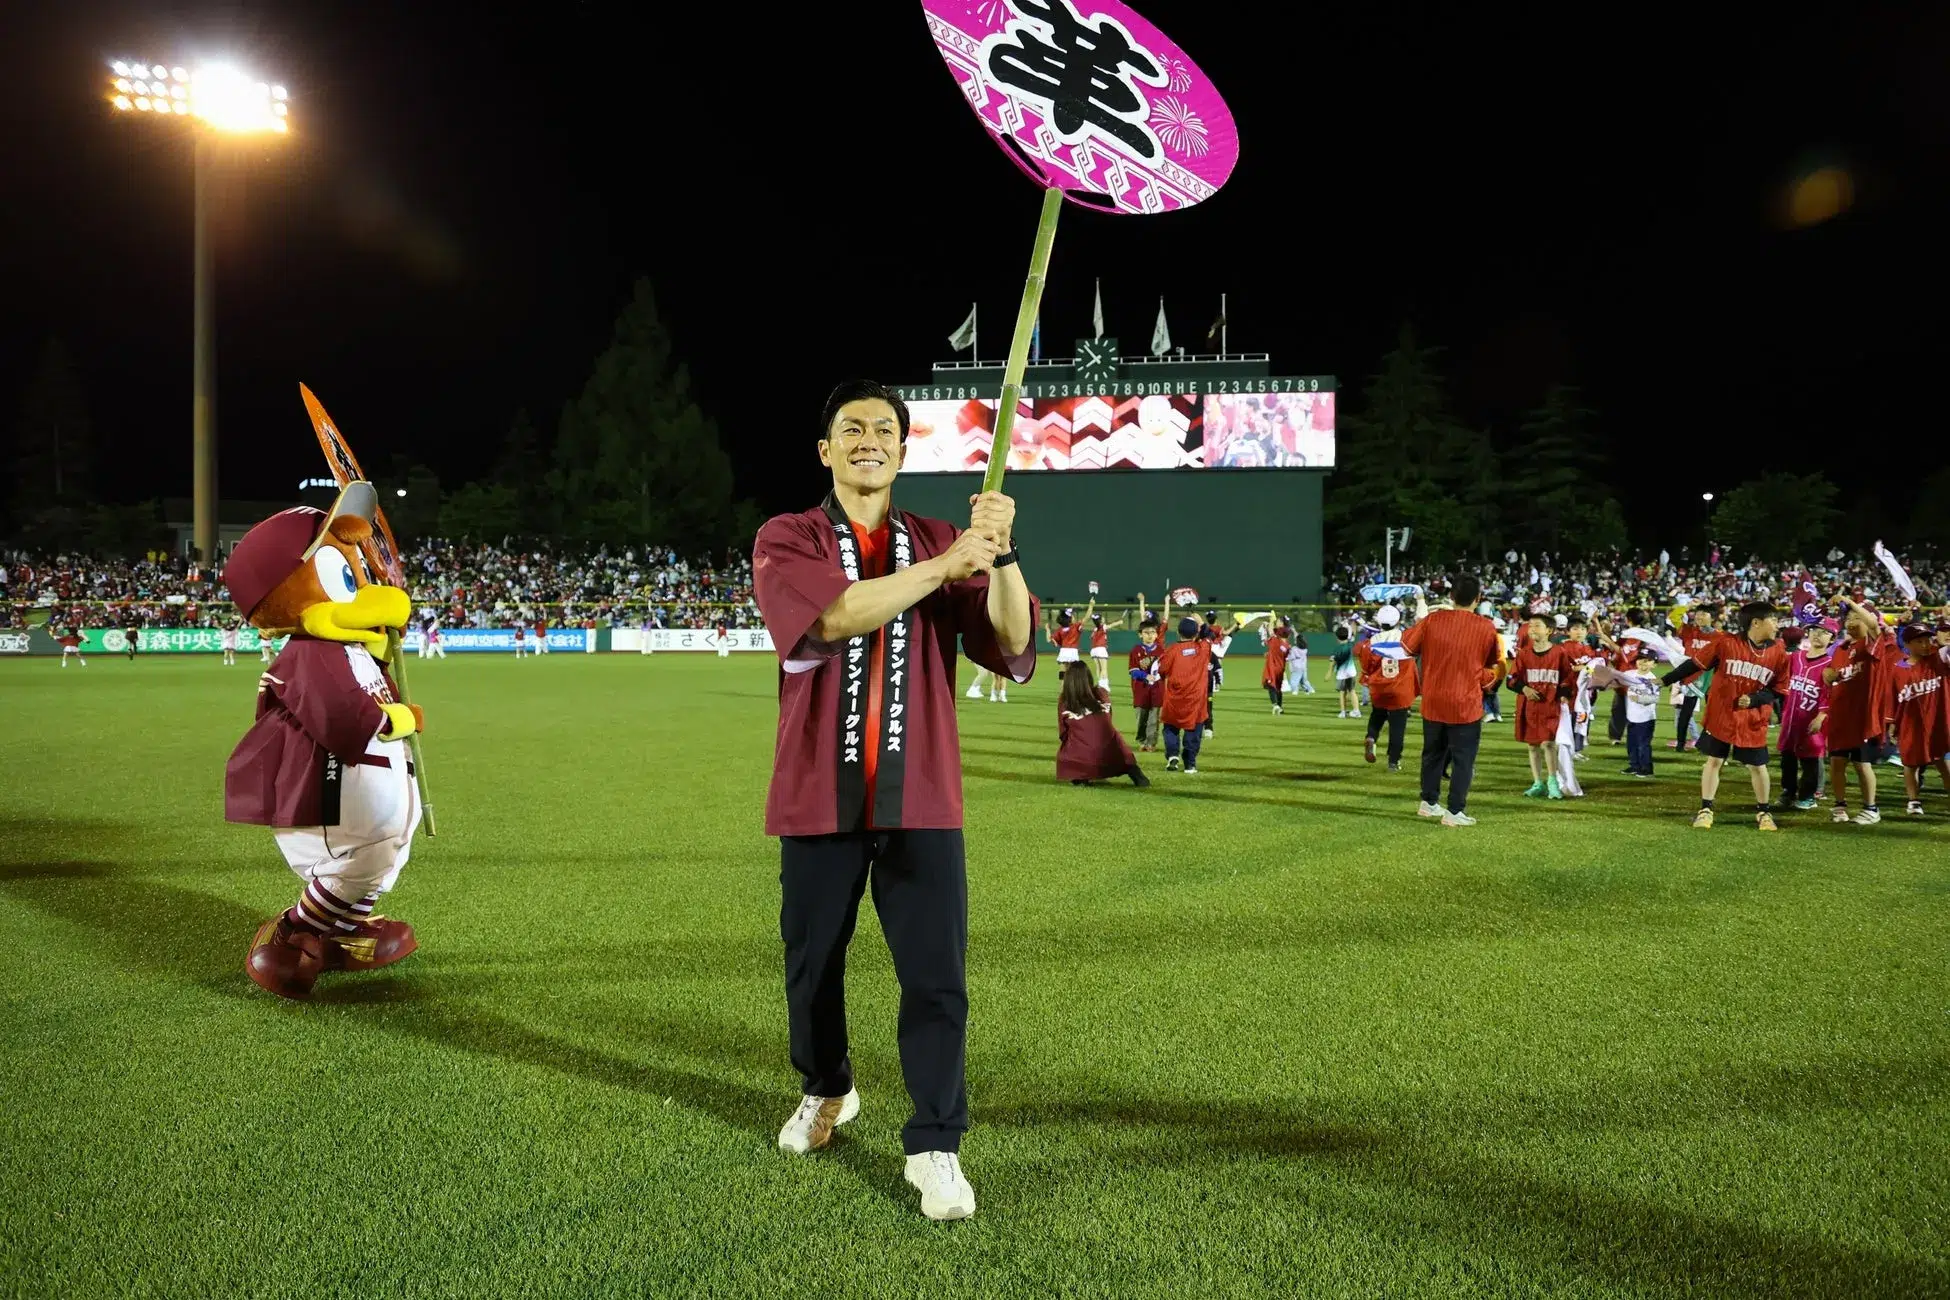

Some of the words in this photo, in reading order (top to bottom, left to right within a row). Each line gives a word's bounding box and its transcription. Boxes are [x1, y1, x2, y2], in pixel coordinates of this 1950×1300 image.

[1038, 385, 1042, 397] 1
[1049, 384, 1056, 397] 2
[1062, 384, 1068, 396] 3
[1074, 384, 1081, 396] 4
[1086, 384, 1094, 396] 5
[1100, 384, 1106, 396] 6
[1112, 384, 1118, 396] 7
[1124, 384, 1132, 395] 8
[1137, 384, 1144, 395] 9
[1149, 382, 1160, 395] 10
[1164, 382, 1172, 394] R
[1176, 382, 1184, 394] H
[1190, 382, 1196, 394] E
[1207, 382, 1212, 393] 1
[1220, 382, 1226, 393] 2
[1232, 381, 1240, 393] 3
[1246, 381, 1252, 392] 4
[1258, 380, 1266, 392] 5
[1272, 380, 1278, 392] 6
[1285, 380, 1291, 392] 7
[1298, 380, 1305, 392] 8
[1311, 380, 1318, 391] 9
[909, 389, 916, 400] 4
[922, 388, 928, 400] 5
[934, 388, 940, 400] 6
[946, 388, 952, 399] 7
[958, 388, 965, 399] 8
[970, 387, 977, 398] 9
[1799, 697, 1818, 711] 27
